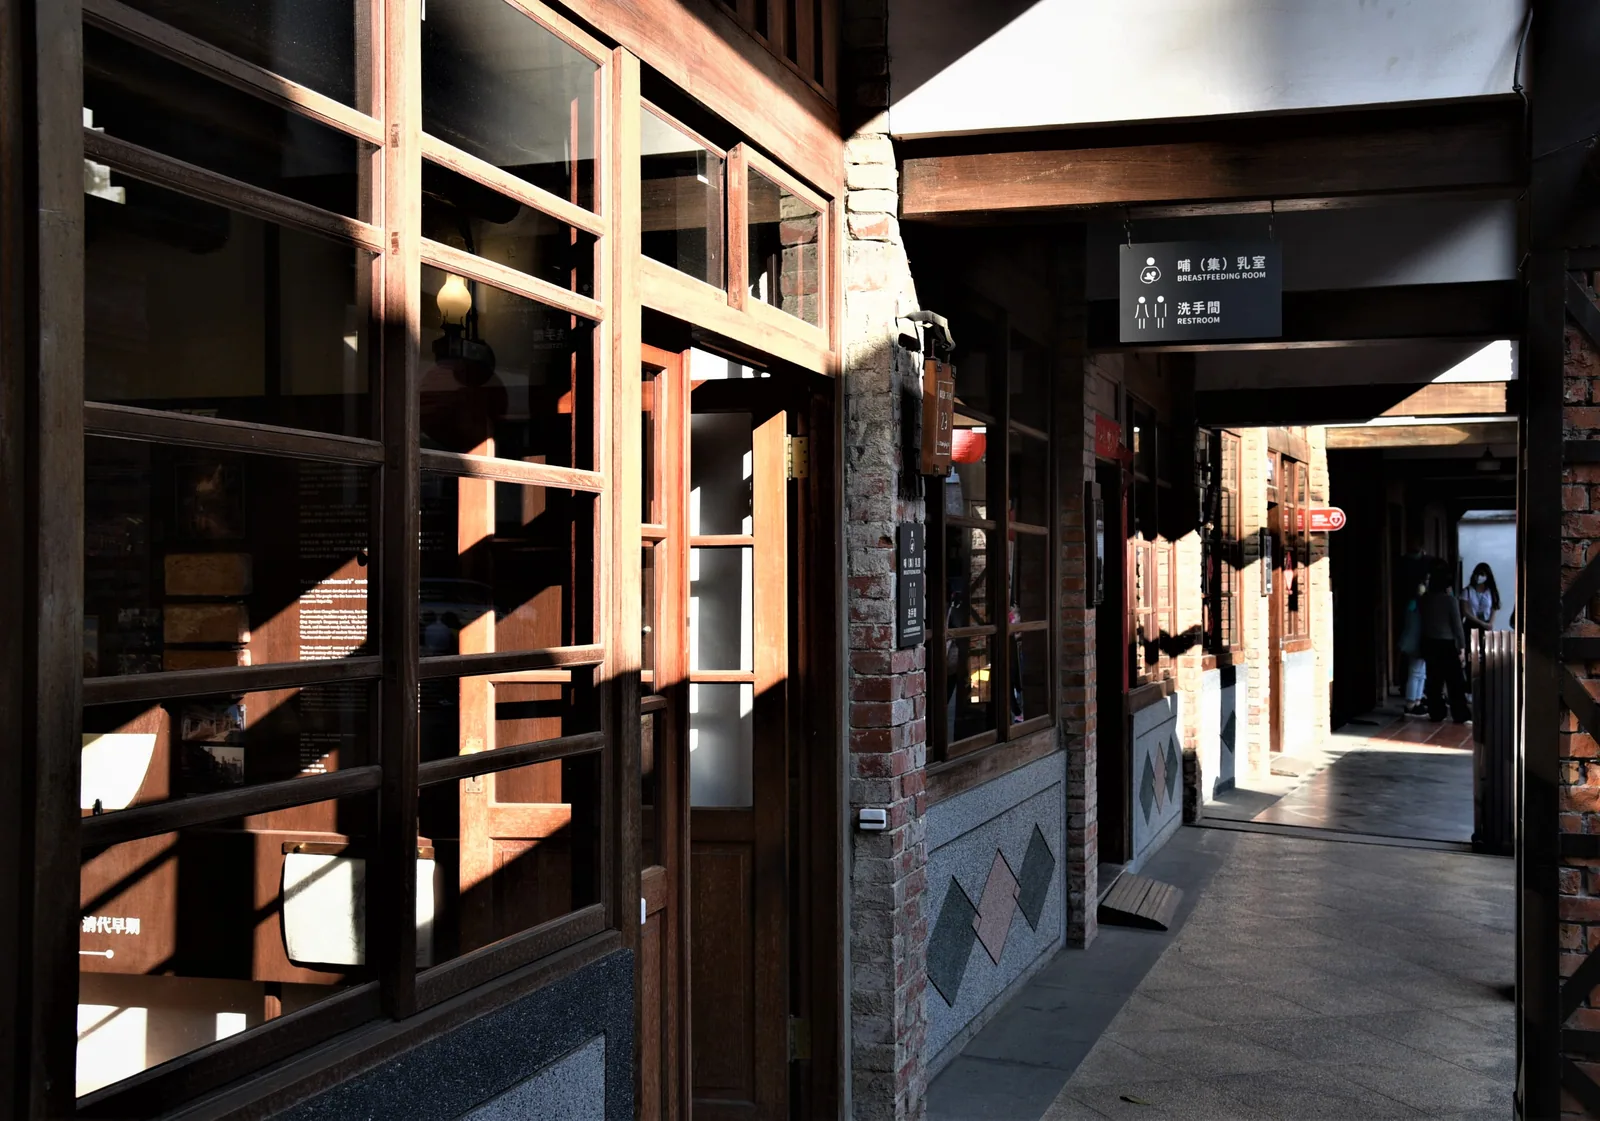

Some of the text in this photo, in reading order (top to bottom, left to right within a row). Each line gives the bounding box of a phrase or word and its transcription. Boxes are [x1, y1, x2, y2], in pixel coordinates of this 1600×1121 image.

[1177, 271, 1266, 282] BREASTFEEDING ROOM
[1177, 300, 1221, 316] 洗手間
[1177, 316, 1221, 325] RESTROOM
[82, 915, 141, 936] 清代早期
